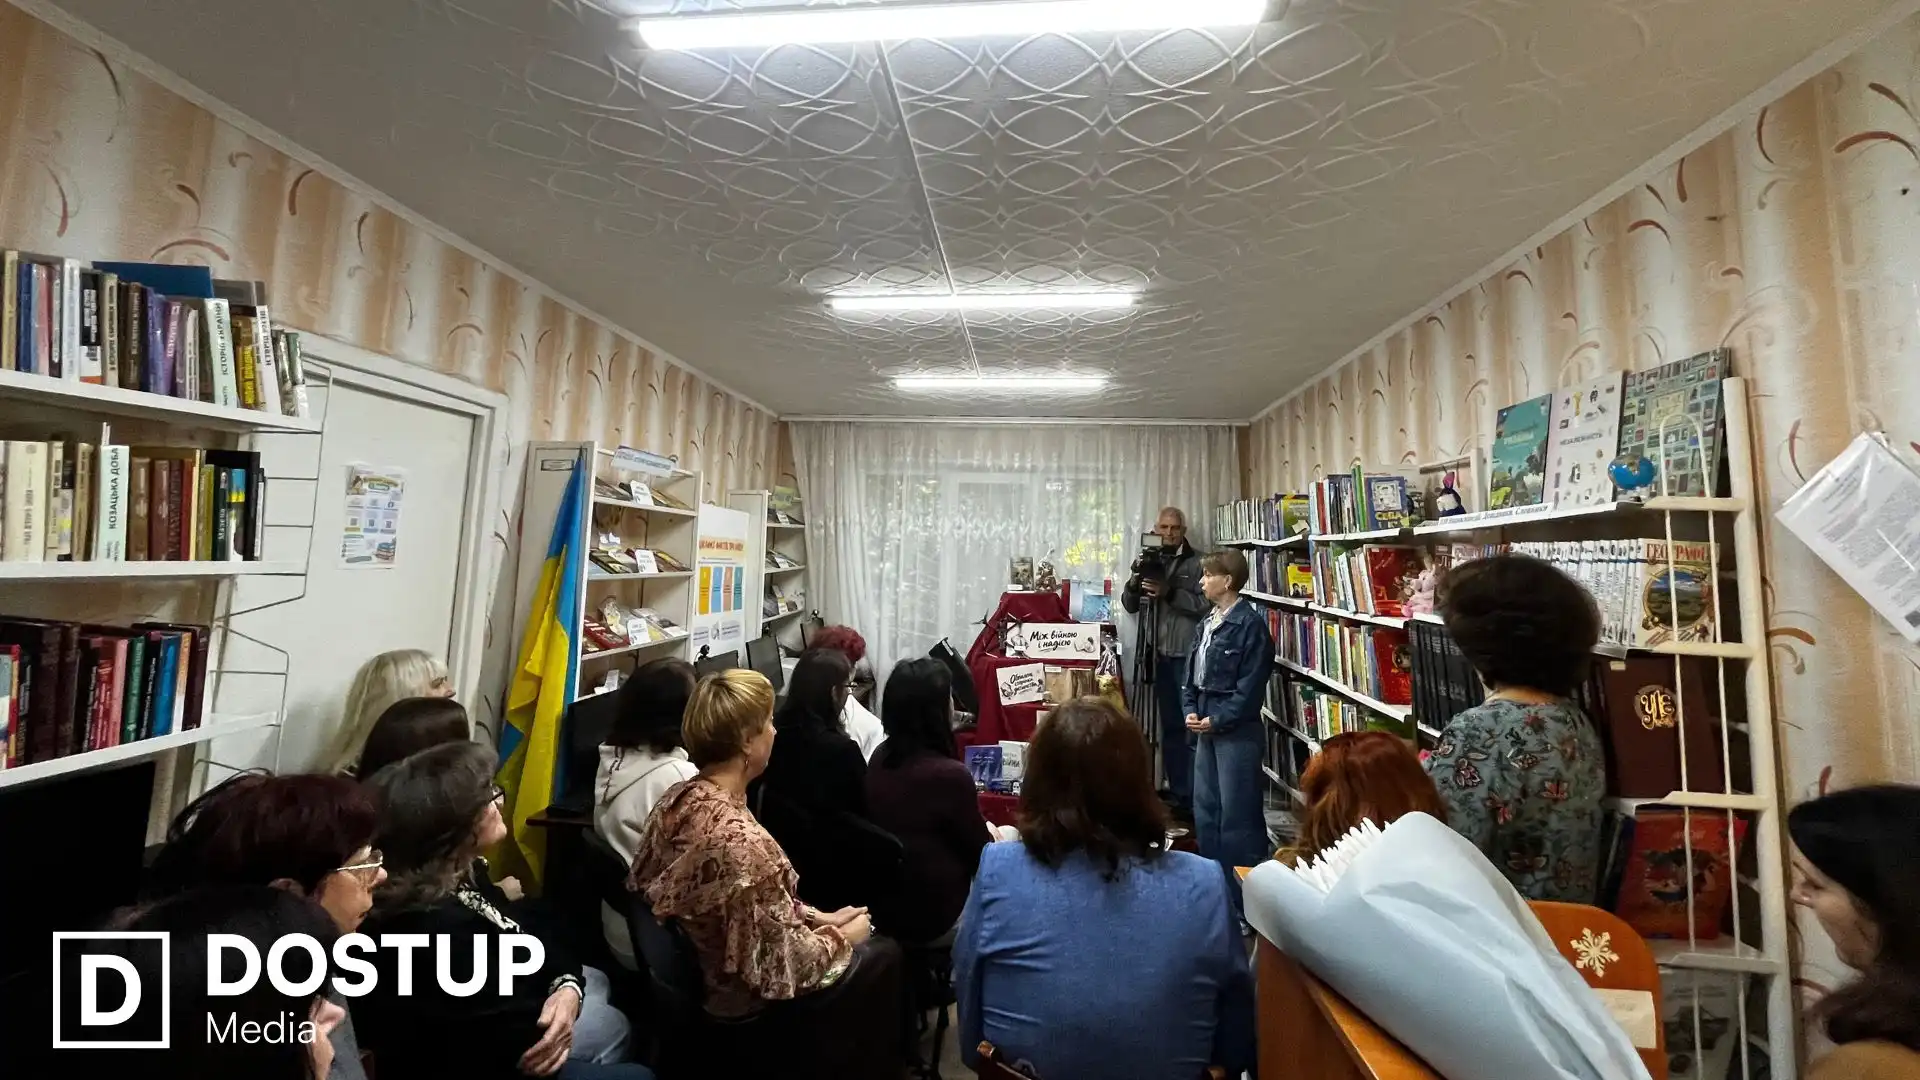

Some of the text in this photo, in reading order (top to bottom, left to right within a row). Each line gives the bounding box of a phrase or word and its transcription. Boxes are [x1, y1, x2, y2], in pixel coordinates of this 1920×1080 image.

[214, 302, 225, 340] УКРАЇНИ
[218, 343, 229, 376] ІСТОРІЯ
[110, 447, 120, 476] ДОБА
[108, 478, 119, 530] КОЗАЦЬКА
[1029, 630, 1078, 642] Між війною
[1042, 640, 1072, 651] надією
